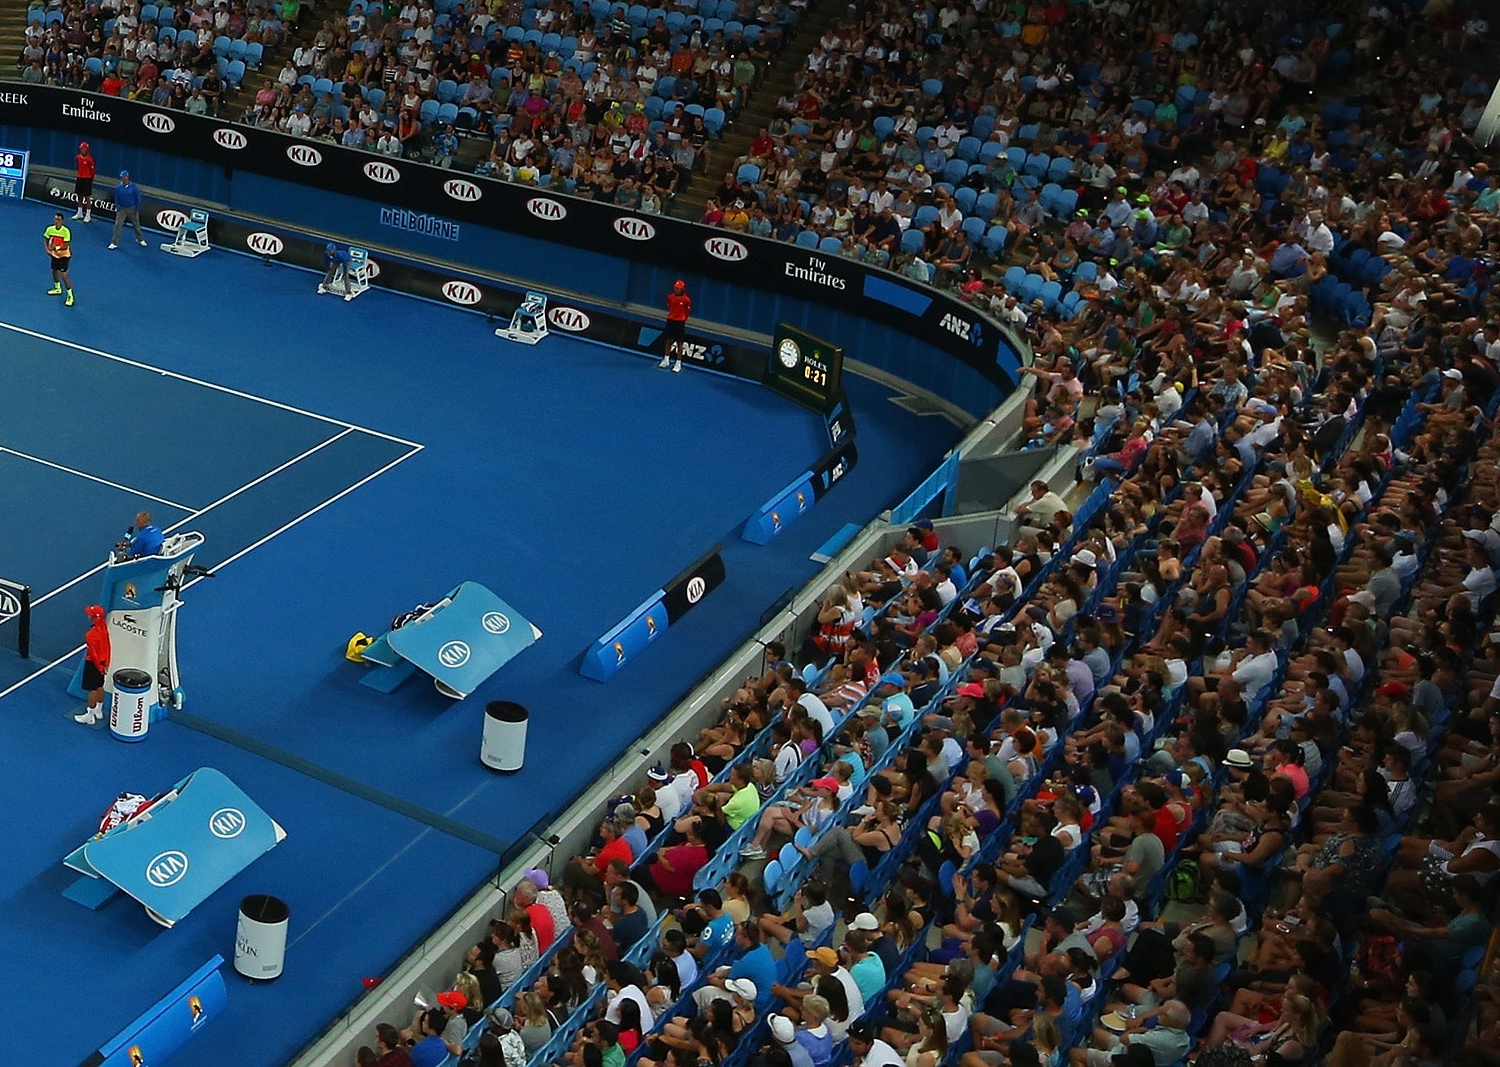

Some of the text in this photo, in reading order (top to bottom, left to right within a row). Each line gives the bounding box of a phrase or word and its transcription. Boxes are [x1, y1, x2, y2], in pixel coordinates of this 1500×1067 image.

[81, 96, 94, 110] Fly
[62, 102, 111, 123] Emirates
[147, 115, 172, 131] KIA
[217, 131, 243, 148] KIA
[291, 147, 318, 164] KIA
[368, 165, 395, 182] KIA
[449, 182, 477, 200] KIA
[94, 197, 118, 213] CREE
[531, 200, 561, 218] KIA
[380, 207, 460, 242] MELBOURNE
[619, 220, 650, 238] KIA
[251, 235, 278, 253] KIA
[710, 241, 744, 258] KIA
[809, 256, 826, 271] Fly
[785, 261, 846, 291] Emirates
[446, 284, 476, 302] KIA
[552, 310, 584, 329] KIA
[939, 312, 972, 341] ANZ
[804, 355, 828, 372] ROLEX
[804, 365, 827, 387] 0:21
[688, 580, 704, 600] KIA
[112, 618, 148, 638] LACOSTE
[485, 614, 507, 631] KIA
[442, 644, 468, 663] KIA
[111, 692, 120, 727] Wilson
[132, 697, 144, 734] Wilson
[215, 812, 242, 834] KIA
[150, 856, 185, 882] KIA
